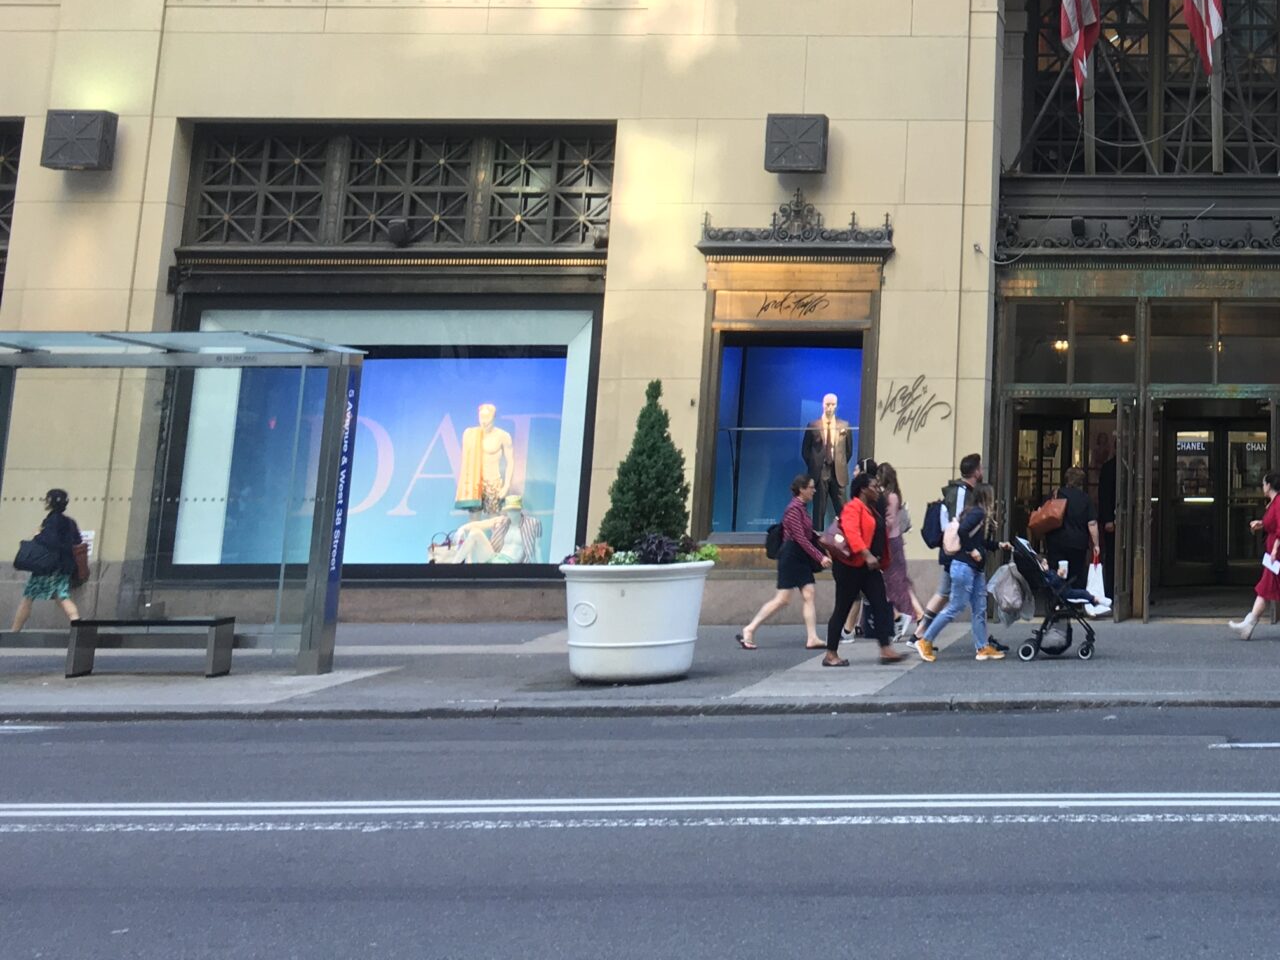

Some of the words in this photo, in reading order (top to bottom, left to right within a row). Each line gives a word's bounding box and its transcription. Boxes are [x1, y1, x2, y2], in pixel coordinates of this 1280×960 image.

[342, 401, 353, 452] Avenue
[337, 469, 347, 505] West
[330, 529, 341, 571] Street
